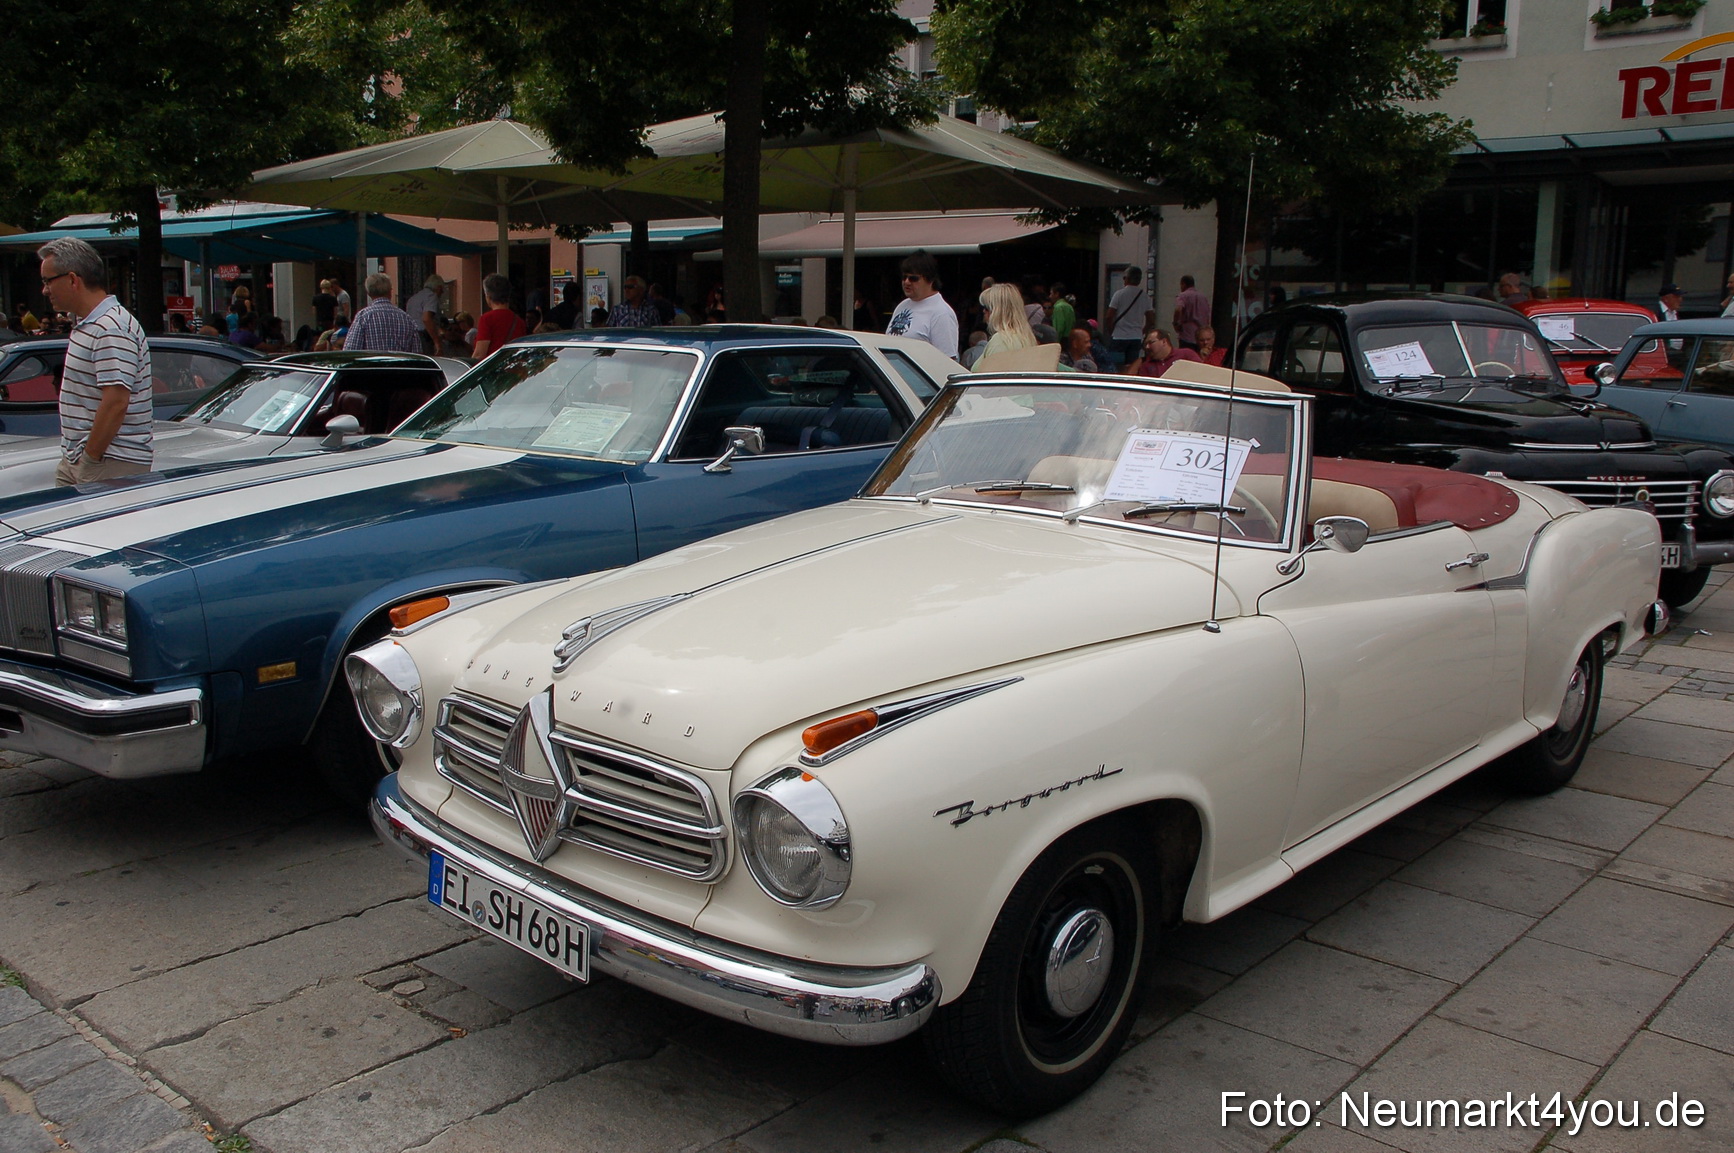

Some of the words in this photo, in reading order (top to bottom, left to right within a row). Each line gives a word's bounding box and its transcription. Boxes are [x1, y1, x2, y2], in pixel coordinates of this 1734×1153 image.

[1395, 350, 1417, 362] 124
[1176, 448, 1226, 472] 302
[933, 764, 1124, 829] Borgward
[433, 883, 439, 894] D
[443, 865, 471, 915] EI
